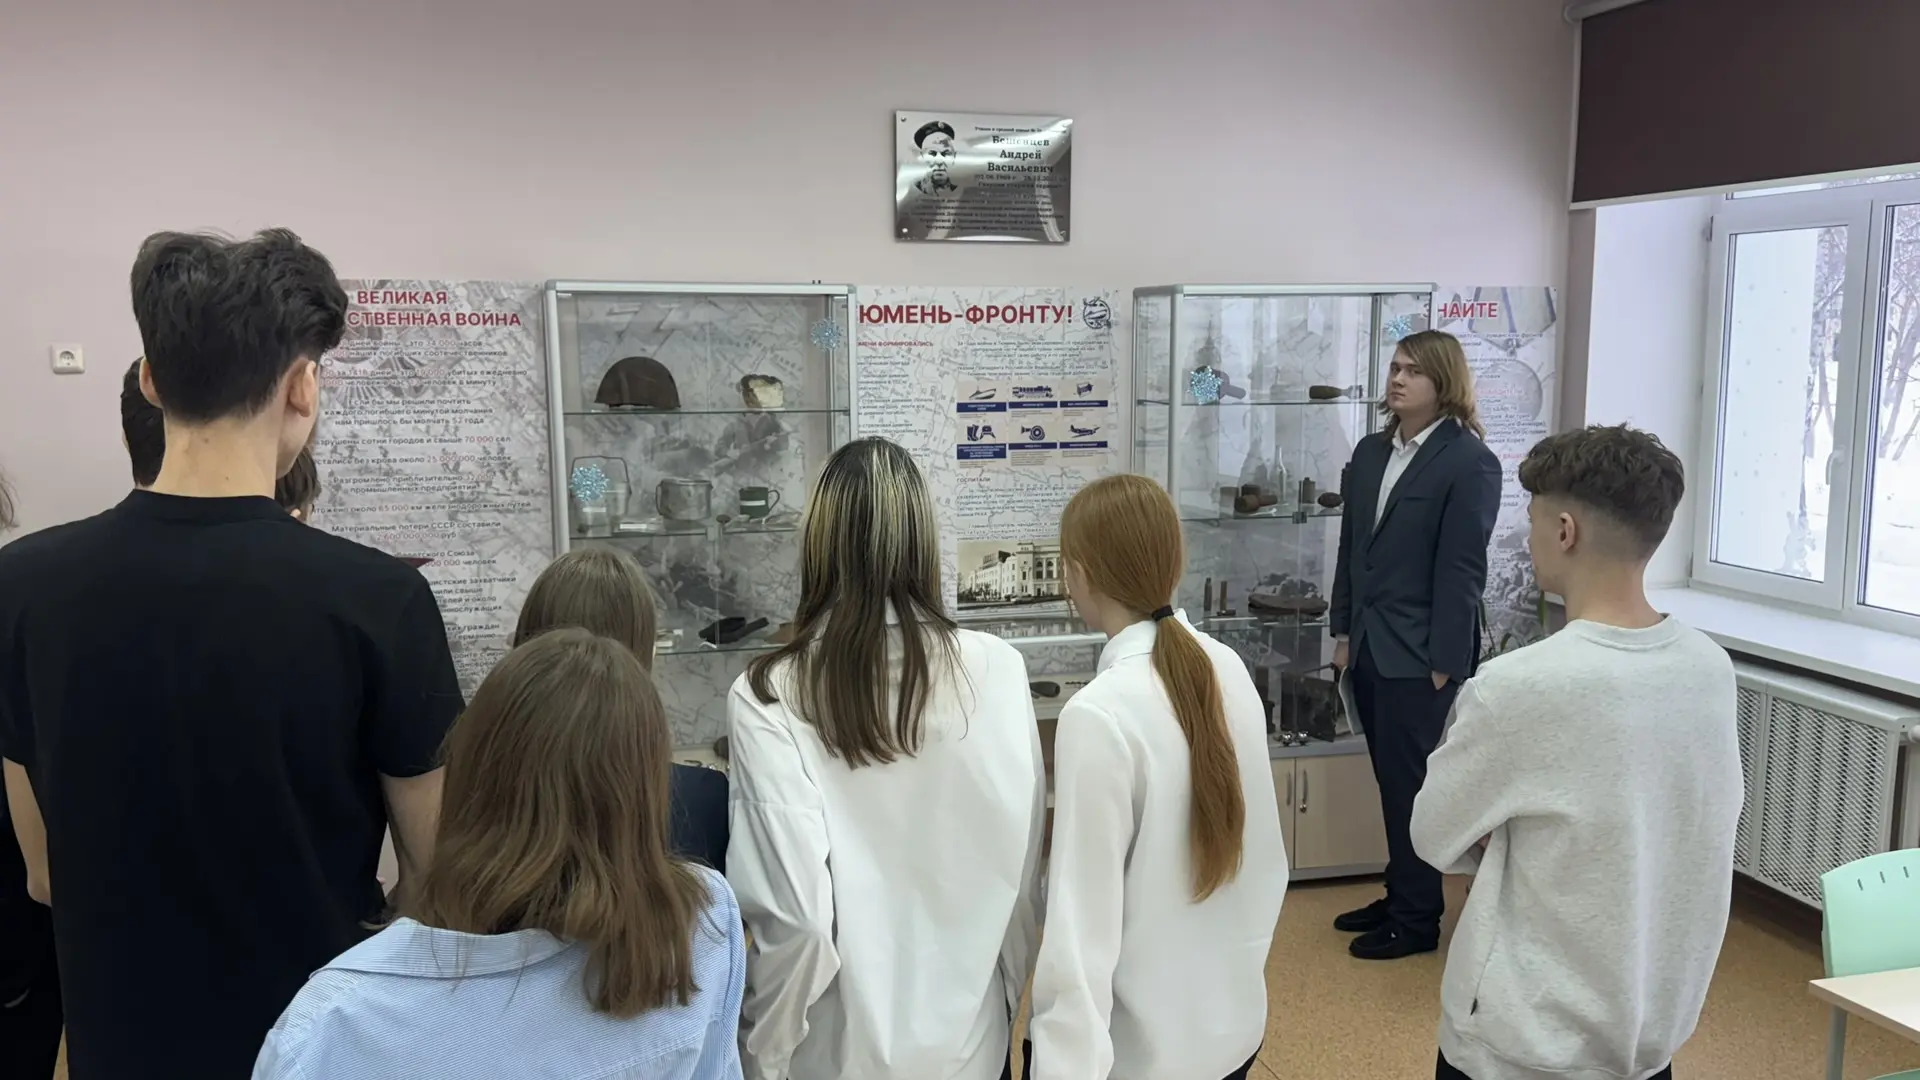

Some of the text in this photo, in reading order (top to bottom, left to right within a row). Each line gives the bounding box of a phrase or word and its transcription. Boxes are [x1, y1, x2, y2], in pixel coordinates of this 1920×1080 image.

[1000, 149, 1042, 161] Андрей
[987, 162, 1054, 173] Васильевич
[357, 290, 448, 306] ВЕЛИКАЯ
[348, 309, 522, 327] СТВЕННАЯ ВОЙНА
[858, 304, 1073, 325] ЮМЕНЬ-ФРОНТУ!
[879, 340, 934, 348] ФОРМИРОВАЛИСЬ
[466, 379, 497, 388] минуту
[372, 397, 384, 405] бы
[401, 399, 435, 407] решили
[412, 407, 450, 416] минутой
[451, 407, 494, 415] молчания
[354, 419, 398, 427] пришлось
[400, 417, 413, 425] бы
[316, 439, 360, 447] азрушены
[389, 438, 425, 446] городов
[350, 485, 418, 494] промышленных
[331, 521, 502, 533] Материальные потери СССР составили
[430, 577, 518, 587] истские захватчики
